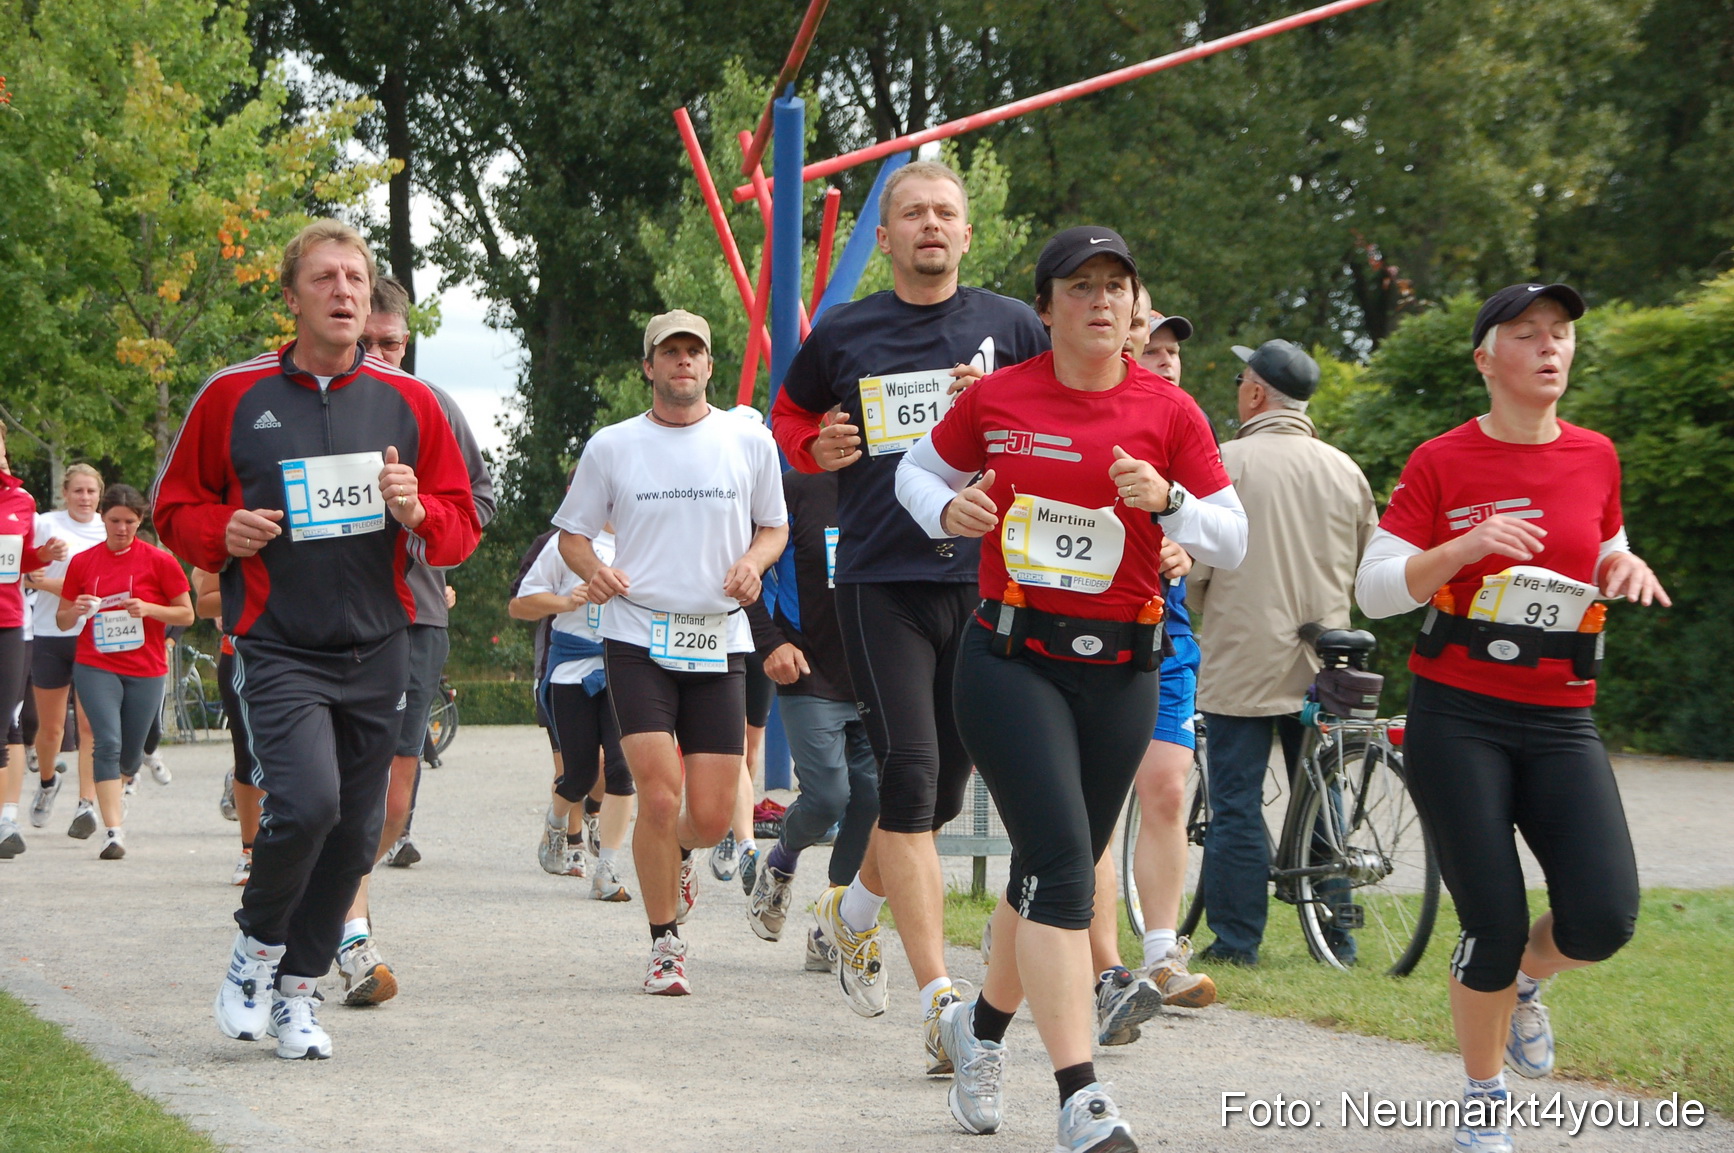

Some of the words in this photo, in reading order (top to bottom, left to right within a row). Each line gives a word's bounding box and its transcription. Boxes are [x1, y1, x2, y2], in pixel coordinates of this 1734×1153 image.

[885, 378, 940, 398] Wojciech
[867, 408, 874, 419] C
[898, 401, 938, 425] 651
[253, 421, 282, 430] adidas
[317, 484, 372, 509] 3451
[635, 487, 737, 502] www.nobodyswife.de
[352, 519, 384, 529] PFLEIDERER
[1037, 507, 1096, 528] Martina
[1007, 528, 1015, 541] C
[1056, 534, 1093, 561] 92
[1513, 573, 1586, 597] Eva-Maria
[1479, 590, 1489, 600] C
[674, 613, 706, 626] Roland
[1524, 602, 1560, 627] 93
[107, 625, 137, 638] 2344
[674, 632, 718, 650] 2206
